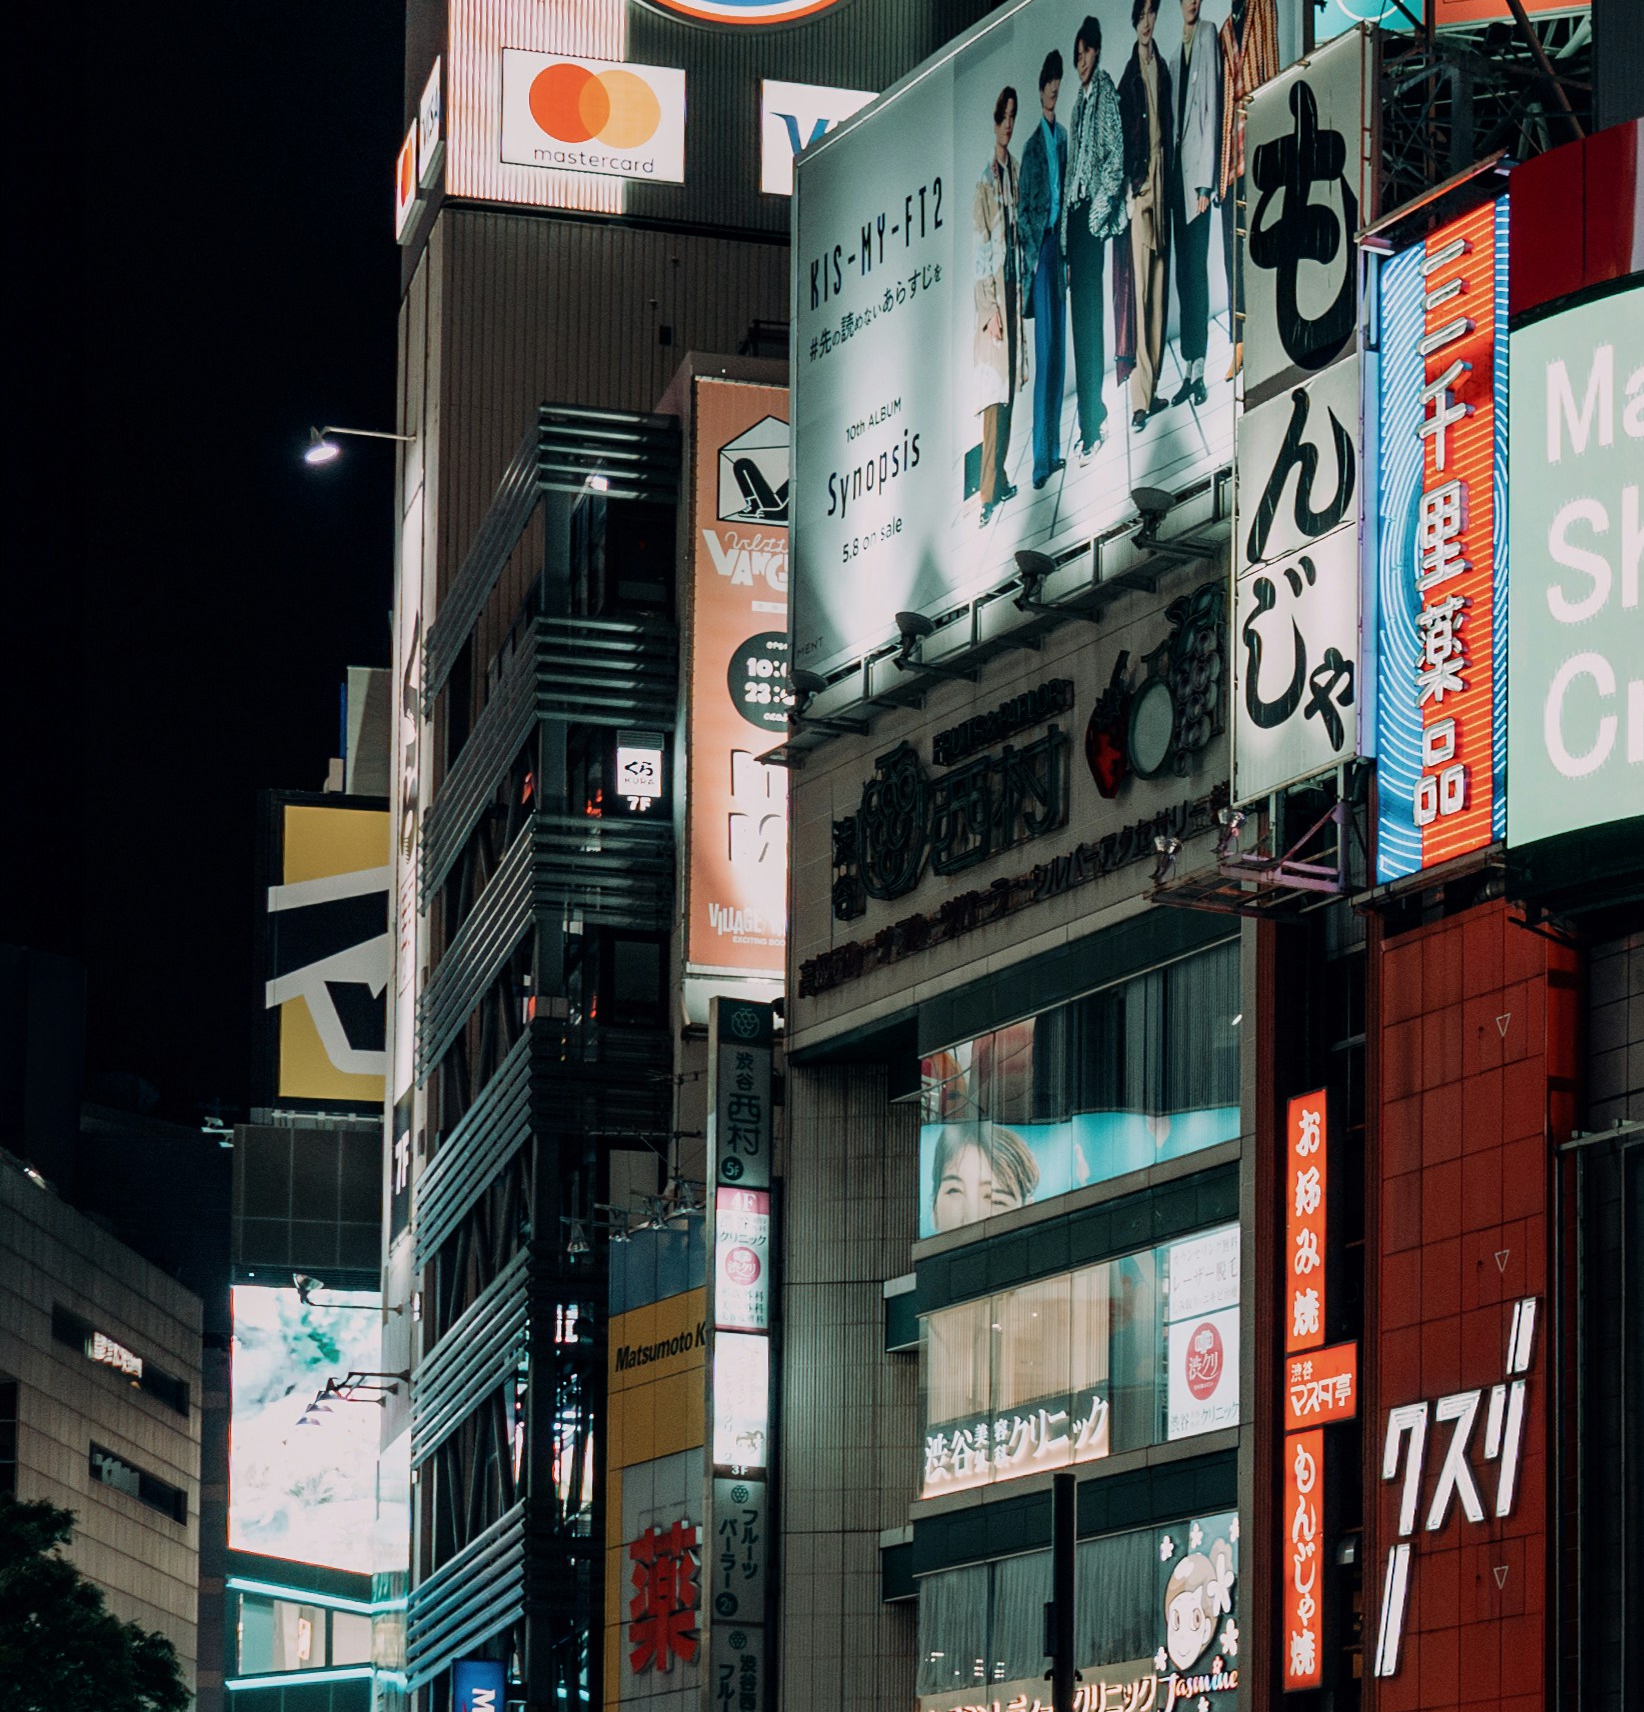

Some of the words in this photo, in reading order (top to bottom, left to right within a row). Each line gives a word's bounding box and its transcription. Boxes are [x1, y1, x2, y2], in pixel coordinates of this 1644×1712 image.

[534, 147, 655, 173] mastercard
[810, 176, 943, 311] KIS-MY-FT2
[846, 418, 866, 444] 10th
[868, 395, 902, 434] ALBUM
[1248, 79, 1357, 752] もんじゃ
[827, 428, 921, 519] Synopsis
[702, 528, 789, 593] VANG
[842, 539, 860, 564] 5.8
[863, 531, 877, 549] on
[879, 516, 903, 543] sale
[1413, 237, 1467, 827] 三千里薬品
[624, 760, 654, 777] くら
[627, 795, 652, 812] 7F
[736, 1051, 754, 1090] 渋谷
[727, 1092, 762, 1157] 西村
[731, 1190, 757, 1213] 4F
[1294, 1109, 1322, 1339] お好み焼
[719, 1230, 767, 1247] クリニック
[614, 1330, 693, 1373] Matsumoto
[1291, 1360, 1314, 1384] 渋谷
[731, 1465, 749, 1476] 3F
[718, 1517, 738, 1590] パーラー
[741, 1509, 758, 1581] フルーツ
[1289, 1443, 1319, 1678] もんじゃ焼
[628, 1518, 704, 1676] 薬
